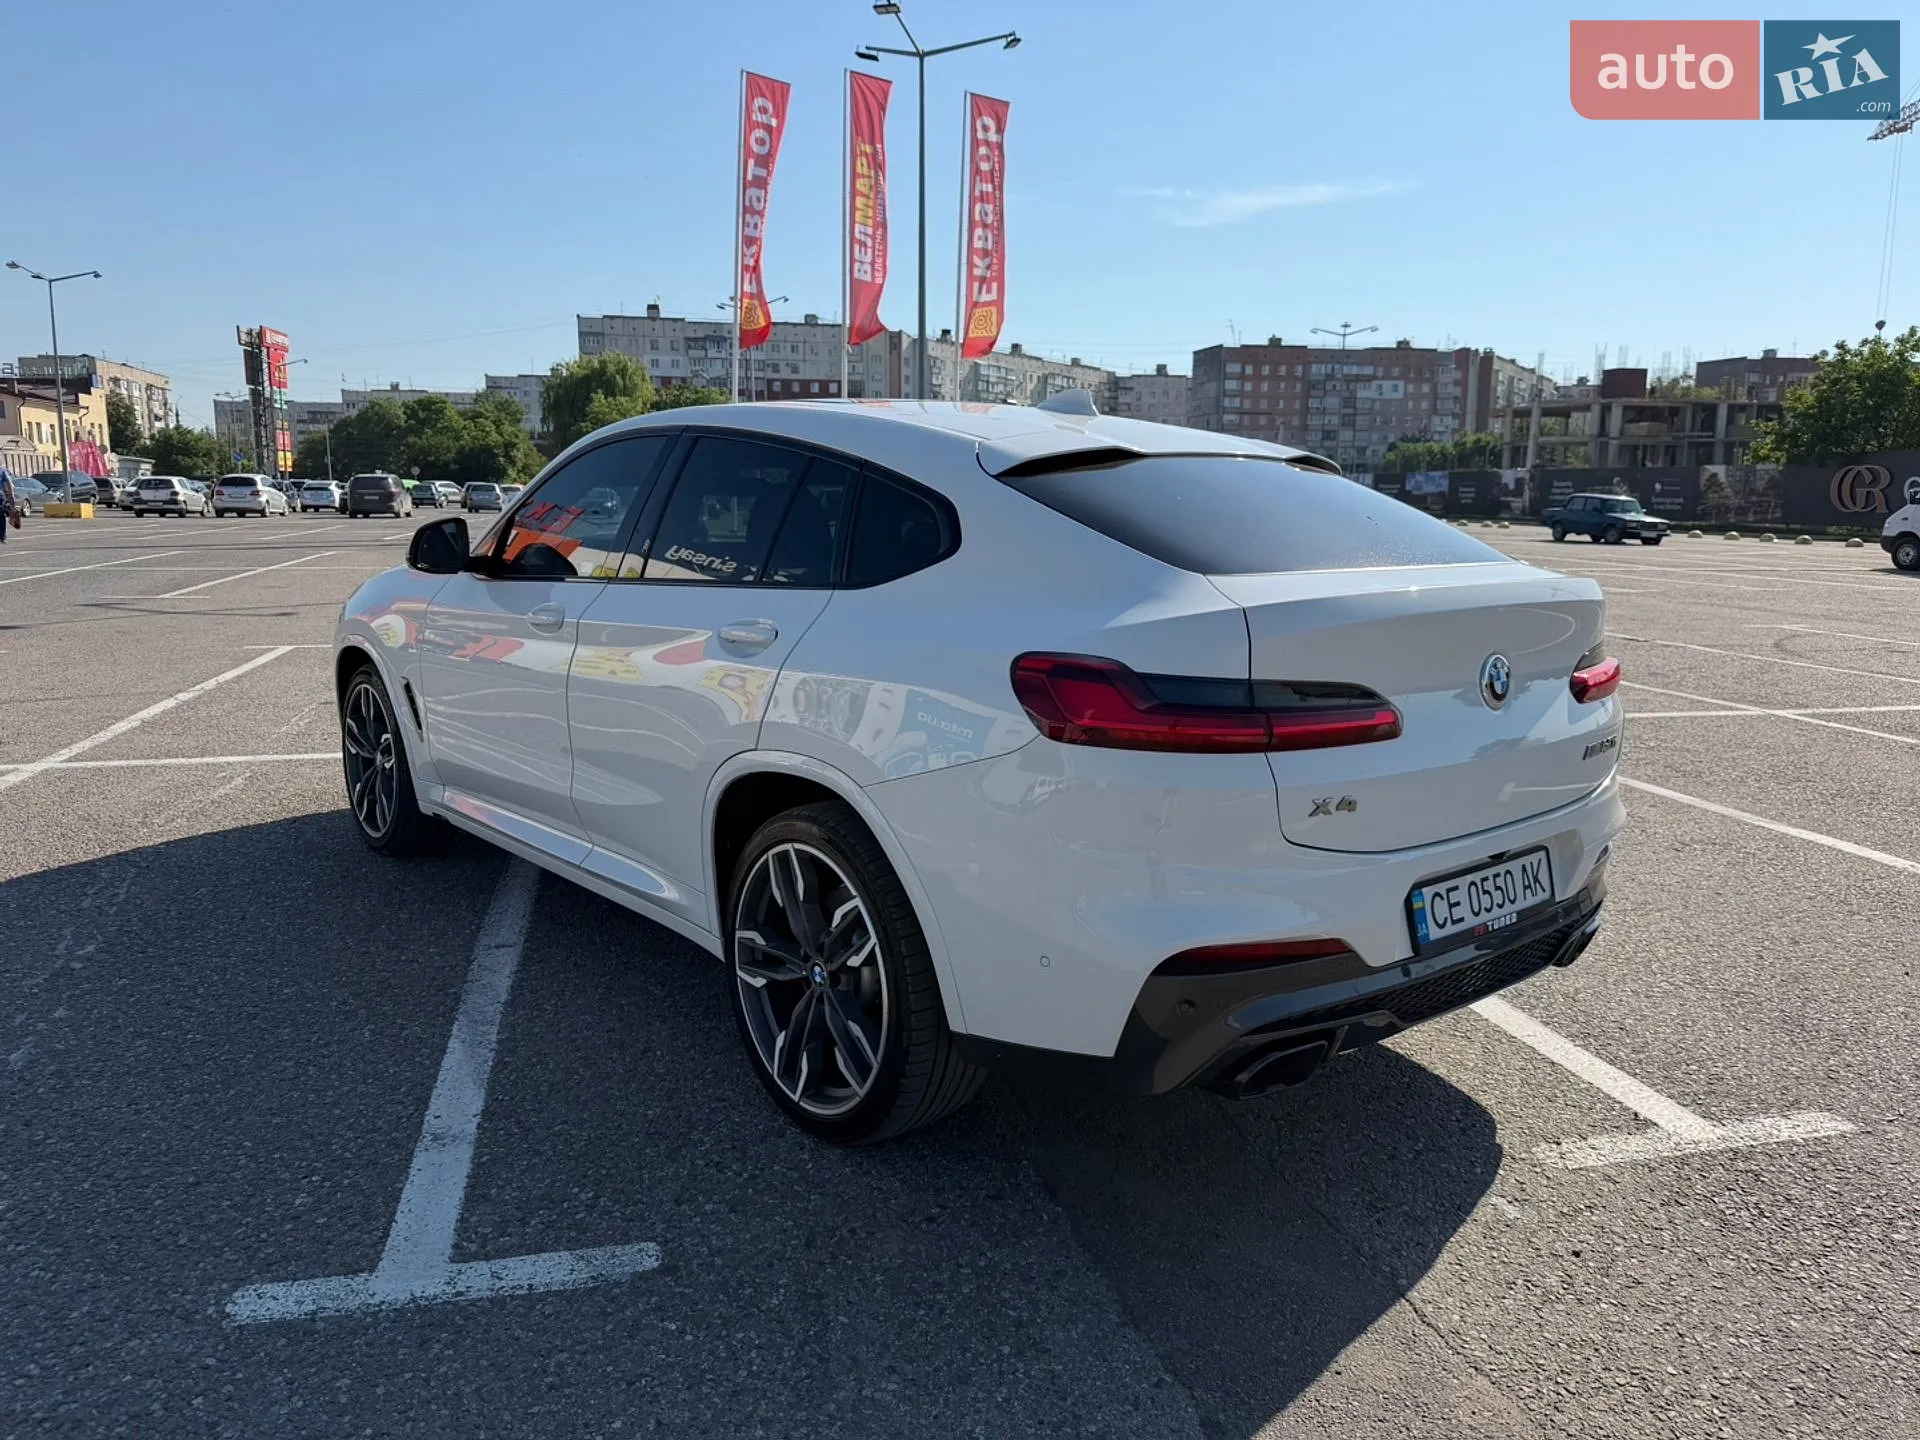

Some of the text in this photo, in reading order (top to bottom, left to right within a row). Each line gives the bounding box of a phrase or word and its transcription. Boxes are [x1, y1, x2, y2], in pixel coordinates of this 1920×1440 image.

[1430, 857, 1547, 930] CE 0550 AK
